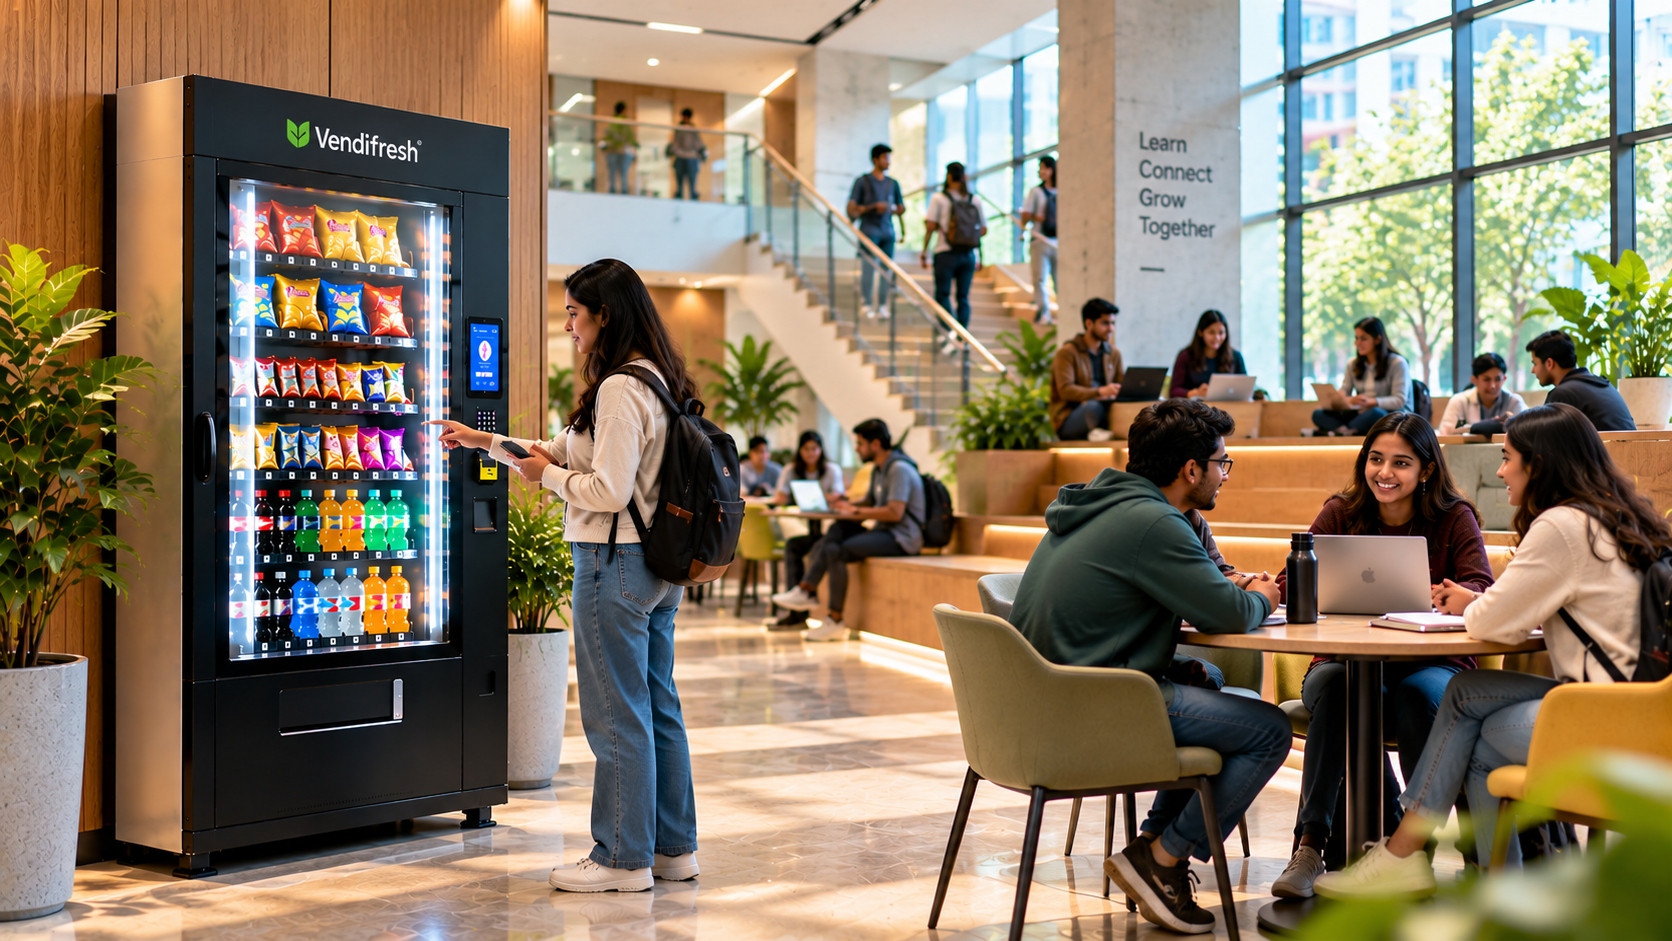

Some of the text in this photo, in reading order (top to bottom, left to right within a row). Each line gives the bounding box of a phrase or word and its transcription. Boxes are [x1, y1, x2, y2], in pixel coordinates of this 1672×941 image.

[314, 126, 418, 163] Vendifresh
[1139, 131, 1187, 153] Learn
[1139, 159, 1213, 184] Connect
[1139, 187, 1187, 208] Grow
[1139, 215, 1216, 241] Together
